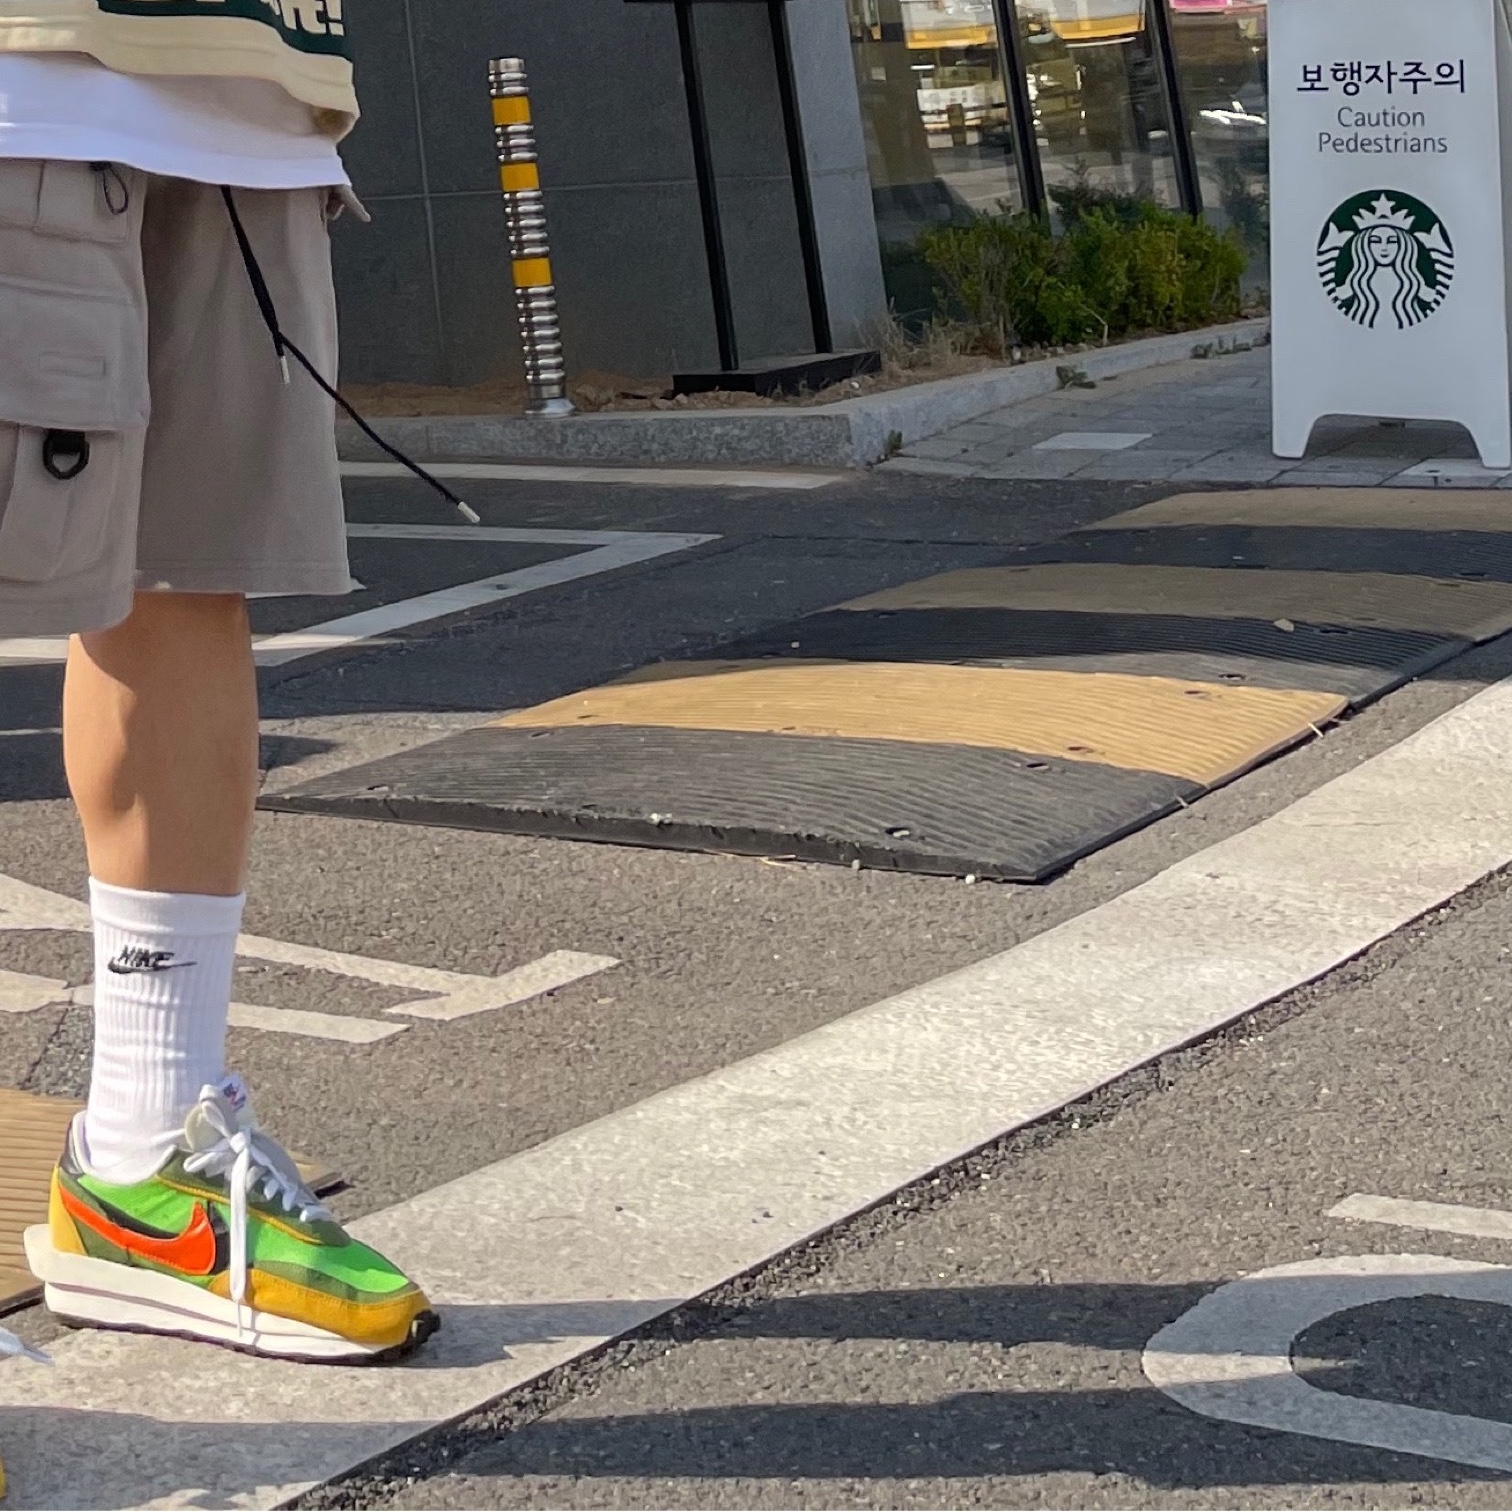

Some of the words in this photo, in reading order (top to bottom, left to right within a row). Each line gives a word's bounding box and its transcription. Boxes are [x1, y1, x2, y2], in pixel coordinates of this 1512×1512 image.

[1296, 59, 1467, 96] 보행자주의
[1337, 106, 1426, 128] Caution
[1318, 131, 1448, 154] Pedestrians
[118, 945, 175, 967] NIKE
